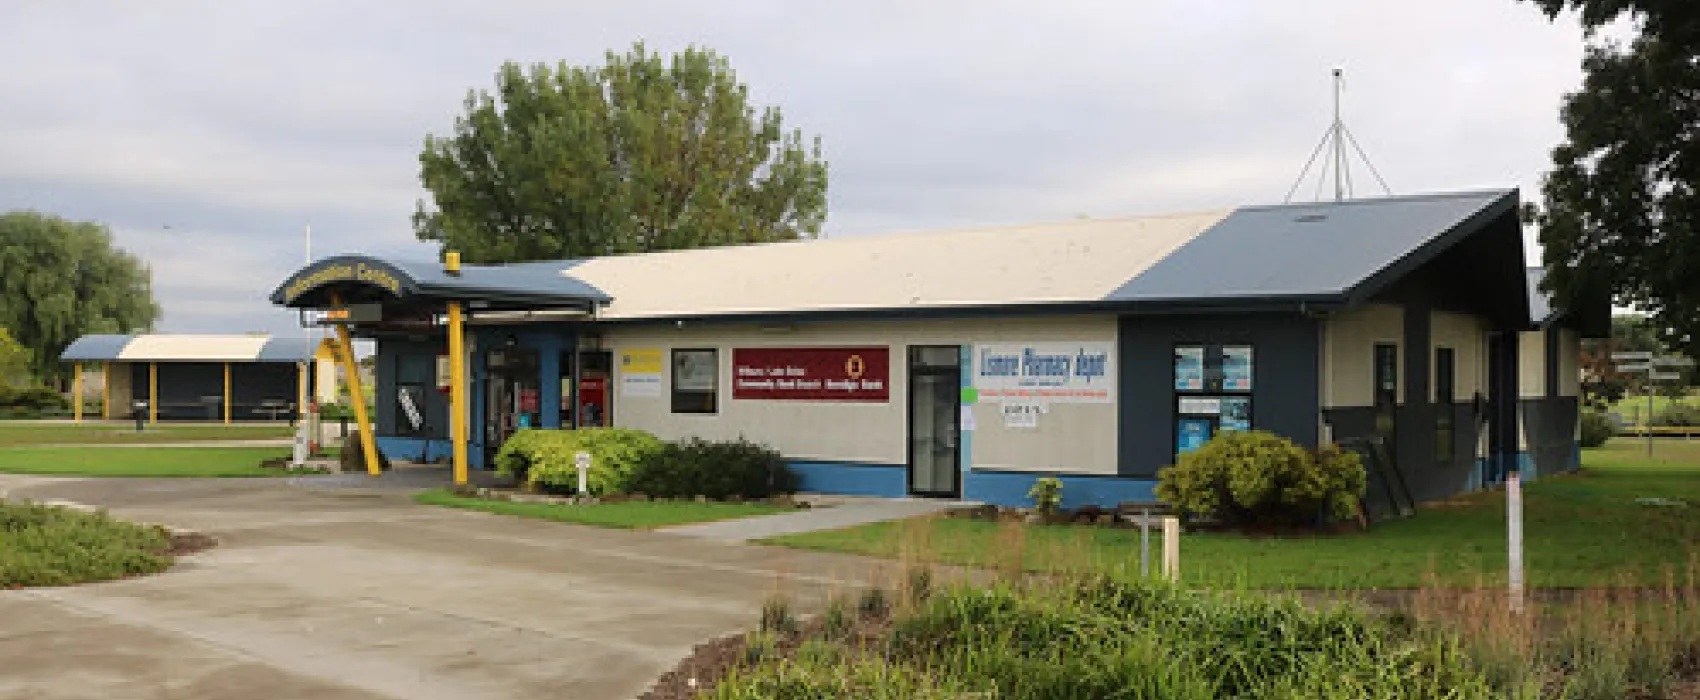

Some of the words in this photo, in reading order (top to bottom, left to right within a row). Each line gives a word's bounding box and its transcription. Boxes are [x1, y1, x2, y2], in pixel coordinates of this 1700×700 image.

[285, 265, 351, 302] Information
[861, 378, 883, 389] Bank
[1021, 346, 1071, 384] Pharmacy
